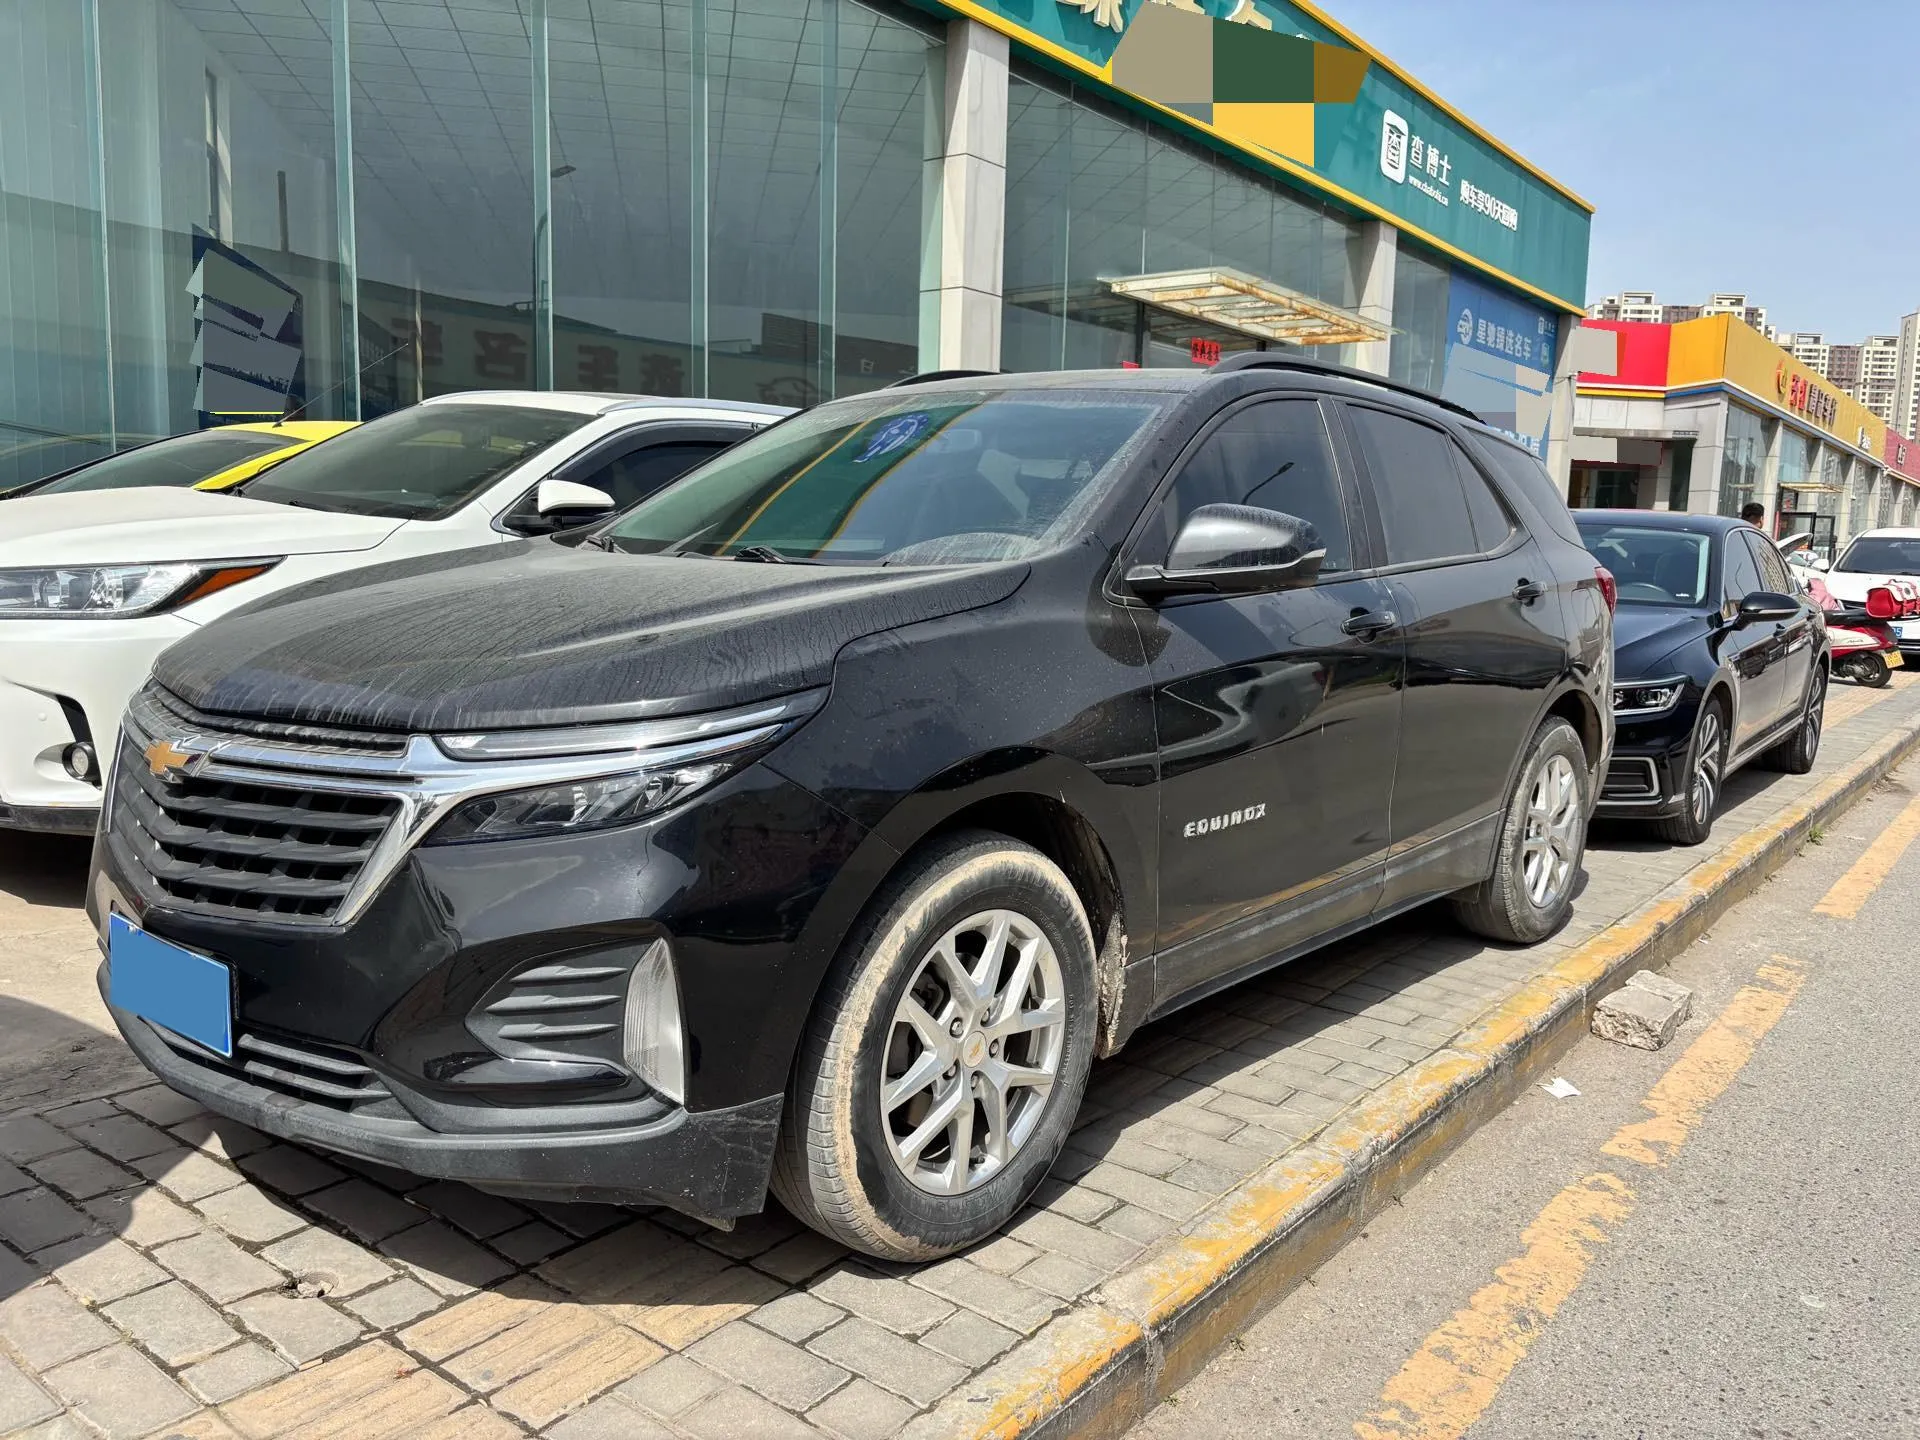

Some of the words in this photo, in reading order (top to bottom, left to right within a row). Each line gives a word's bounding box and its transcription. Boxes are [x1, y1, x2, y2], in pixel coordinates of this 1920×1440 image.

[1410, 134, 1452, 186] 查博士
[1459, 178, 1519, 232] 购车享90天回购
[1183, 803, 1267, 838] EQUINOX
